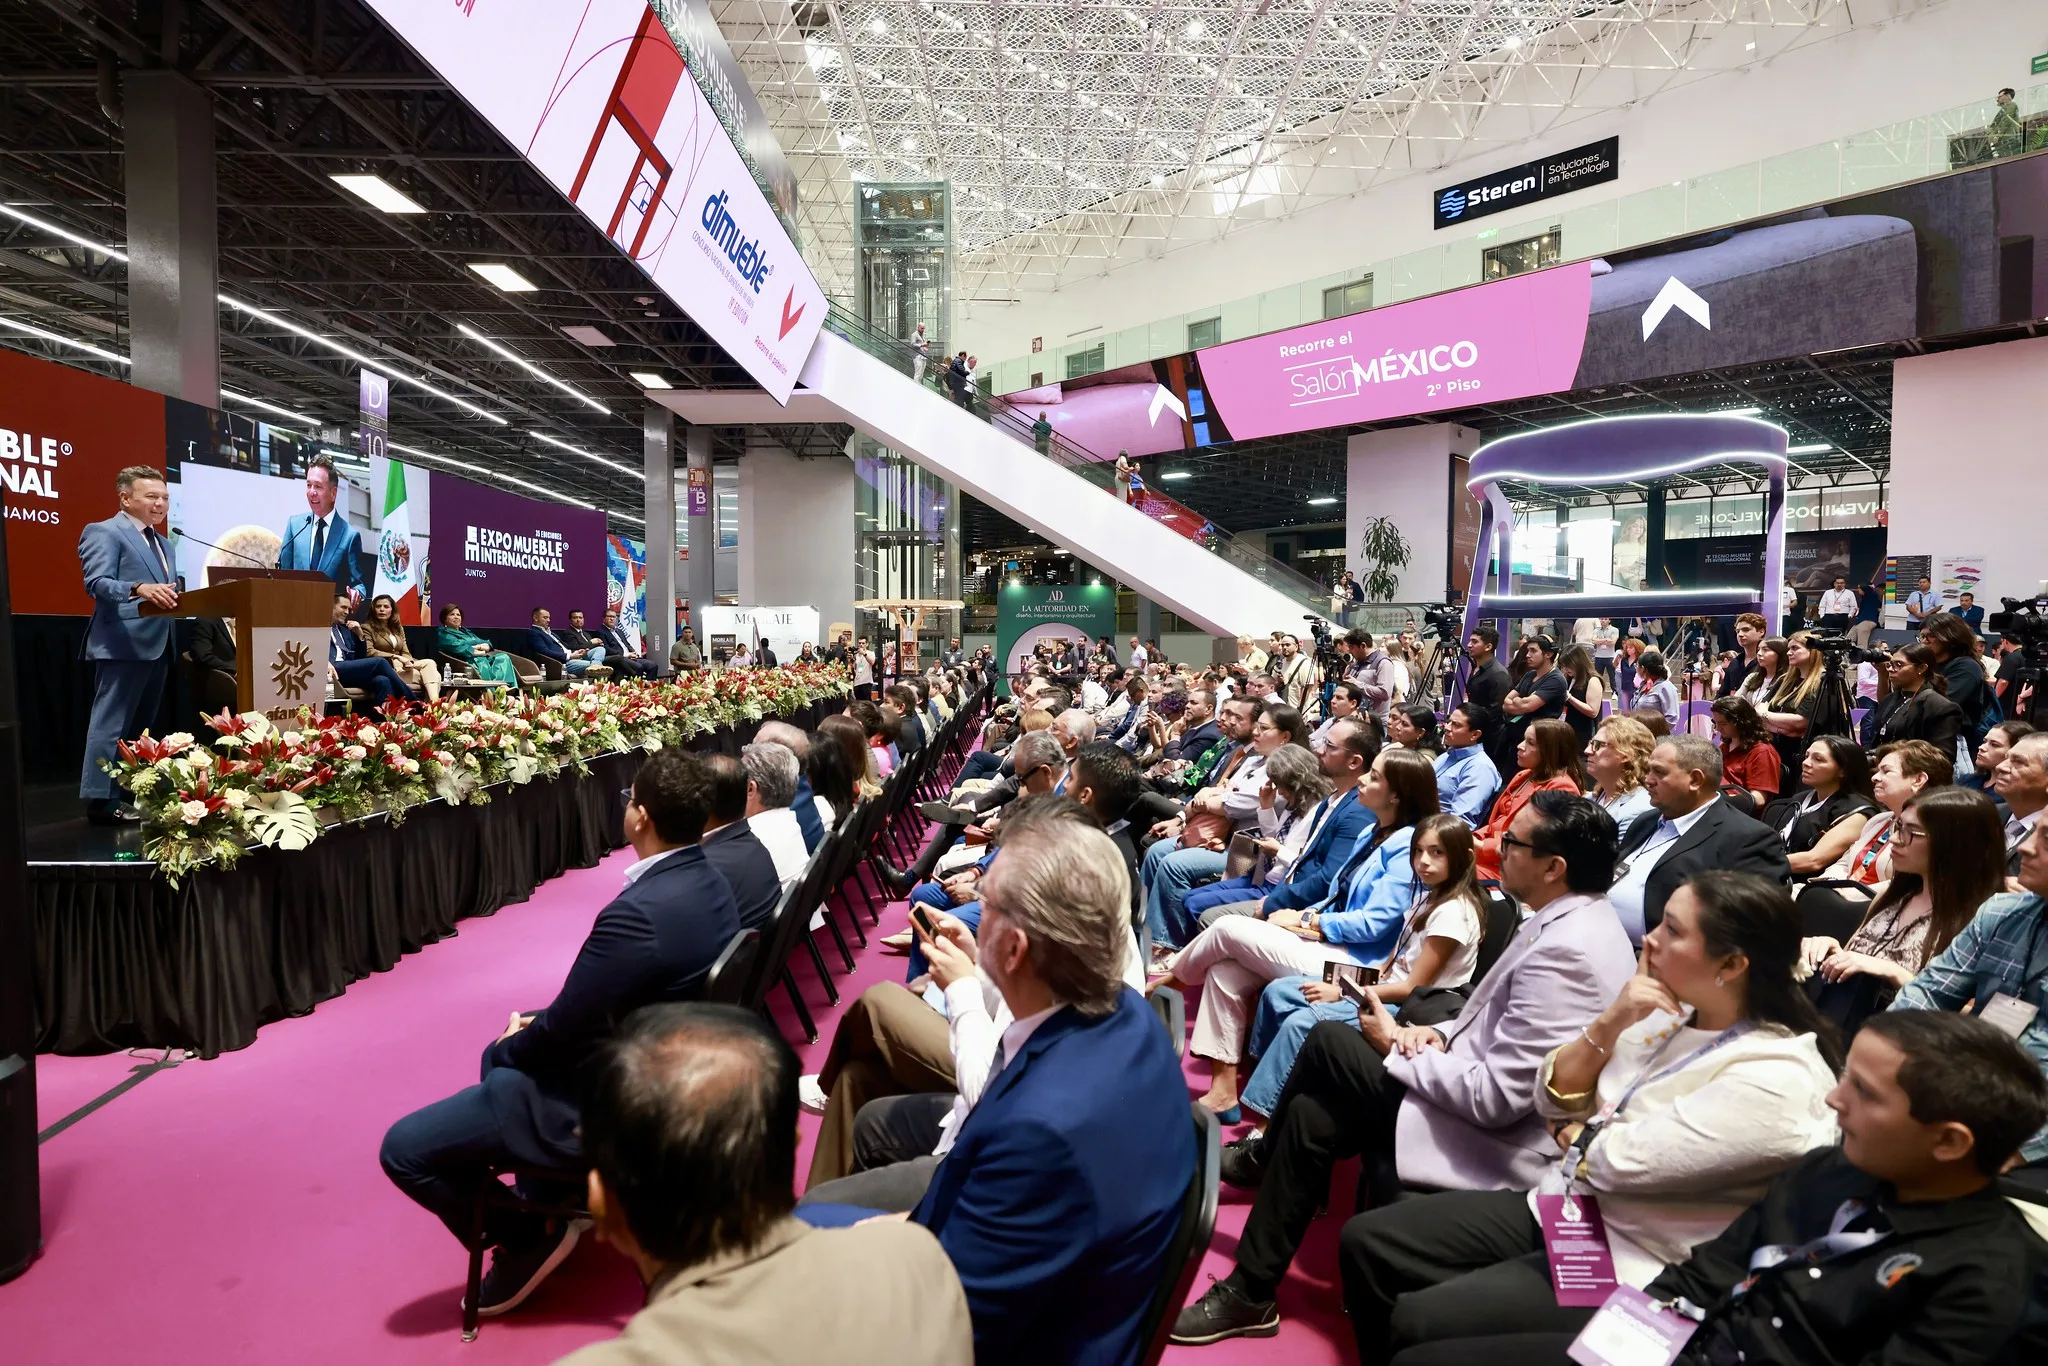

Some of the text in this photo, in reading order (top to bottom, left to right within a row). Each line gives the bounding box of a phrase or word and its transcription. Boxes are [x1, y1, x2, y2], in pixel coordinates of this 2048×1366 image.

[1548, 153, 1600, 175] Soluciones
[1548, 159, 1610, 185] en Tecnología
[1467, 176, 1535, 207] Steren
[754, 335, 770, 357] Recorre
[1279, 330, 1353, 358] Recorre el
[1353, 340, 1478, 387] MÉXICO
[369, 380, 383, 409] D
[1447, 379, 1481, 395] Piso
[365, 432, 384, 457] 10
[696, 491, 707, 505] B
[480, 528, 512, 551] EXPO
[480, 546, 565, 573] INTERNACIONAL
[464, 568, 487, 578] JUNTOS
[1048, 590, 1064, 601] AD
